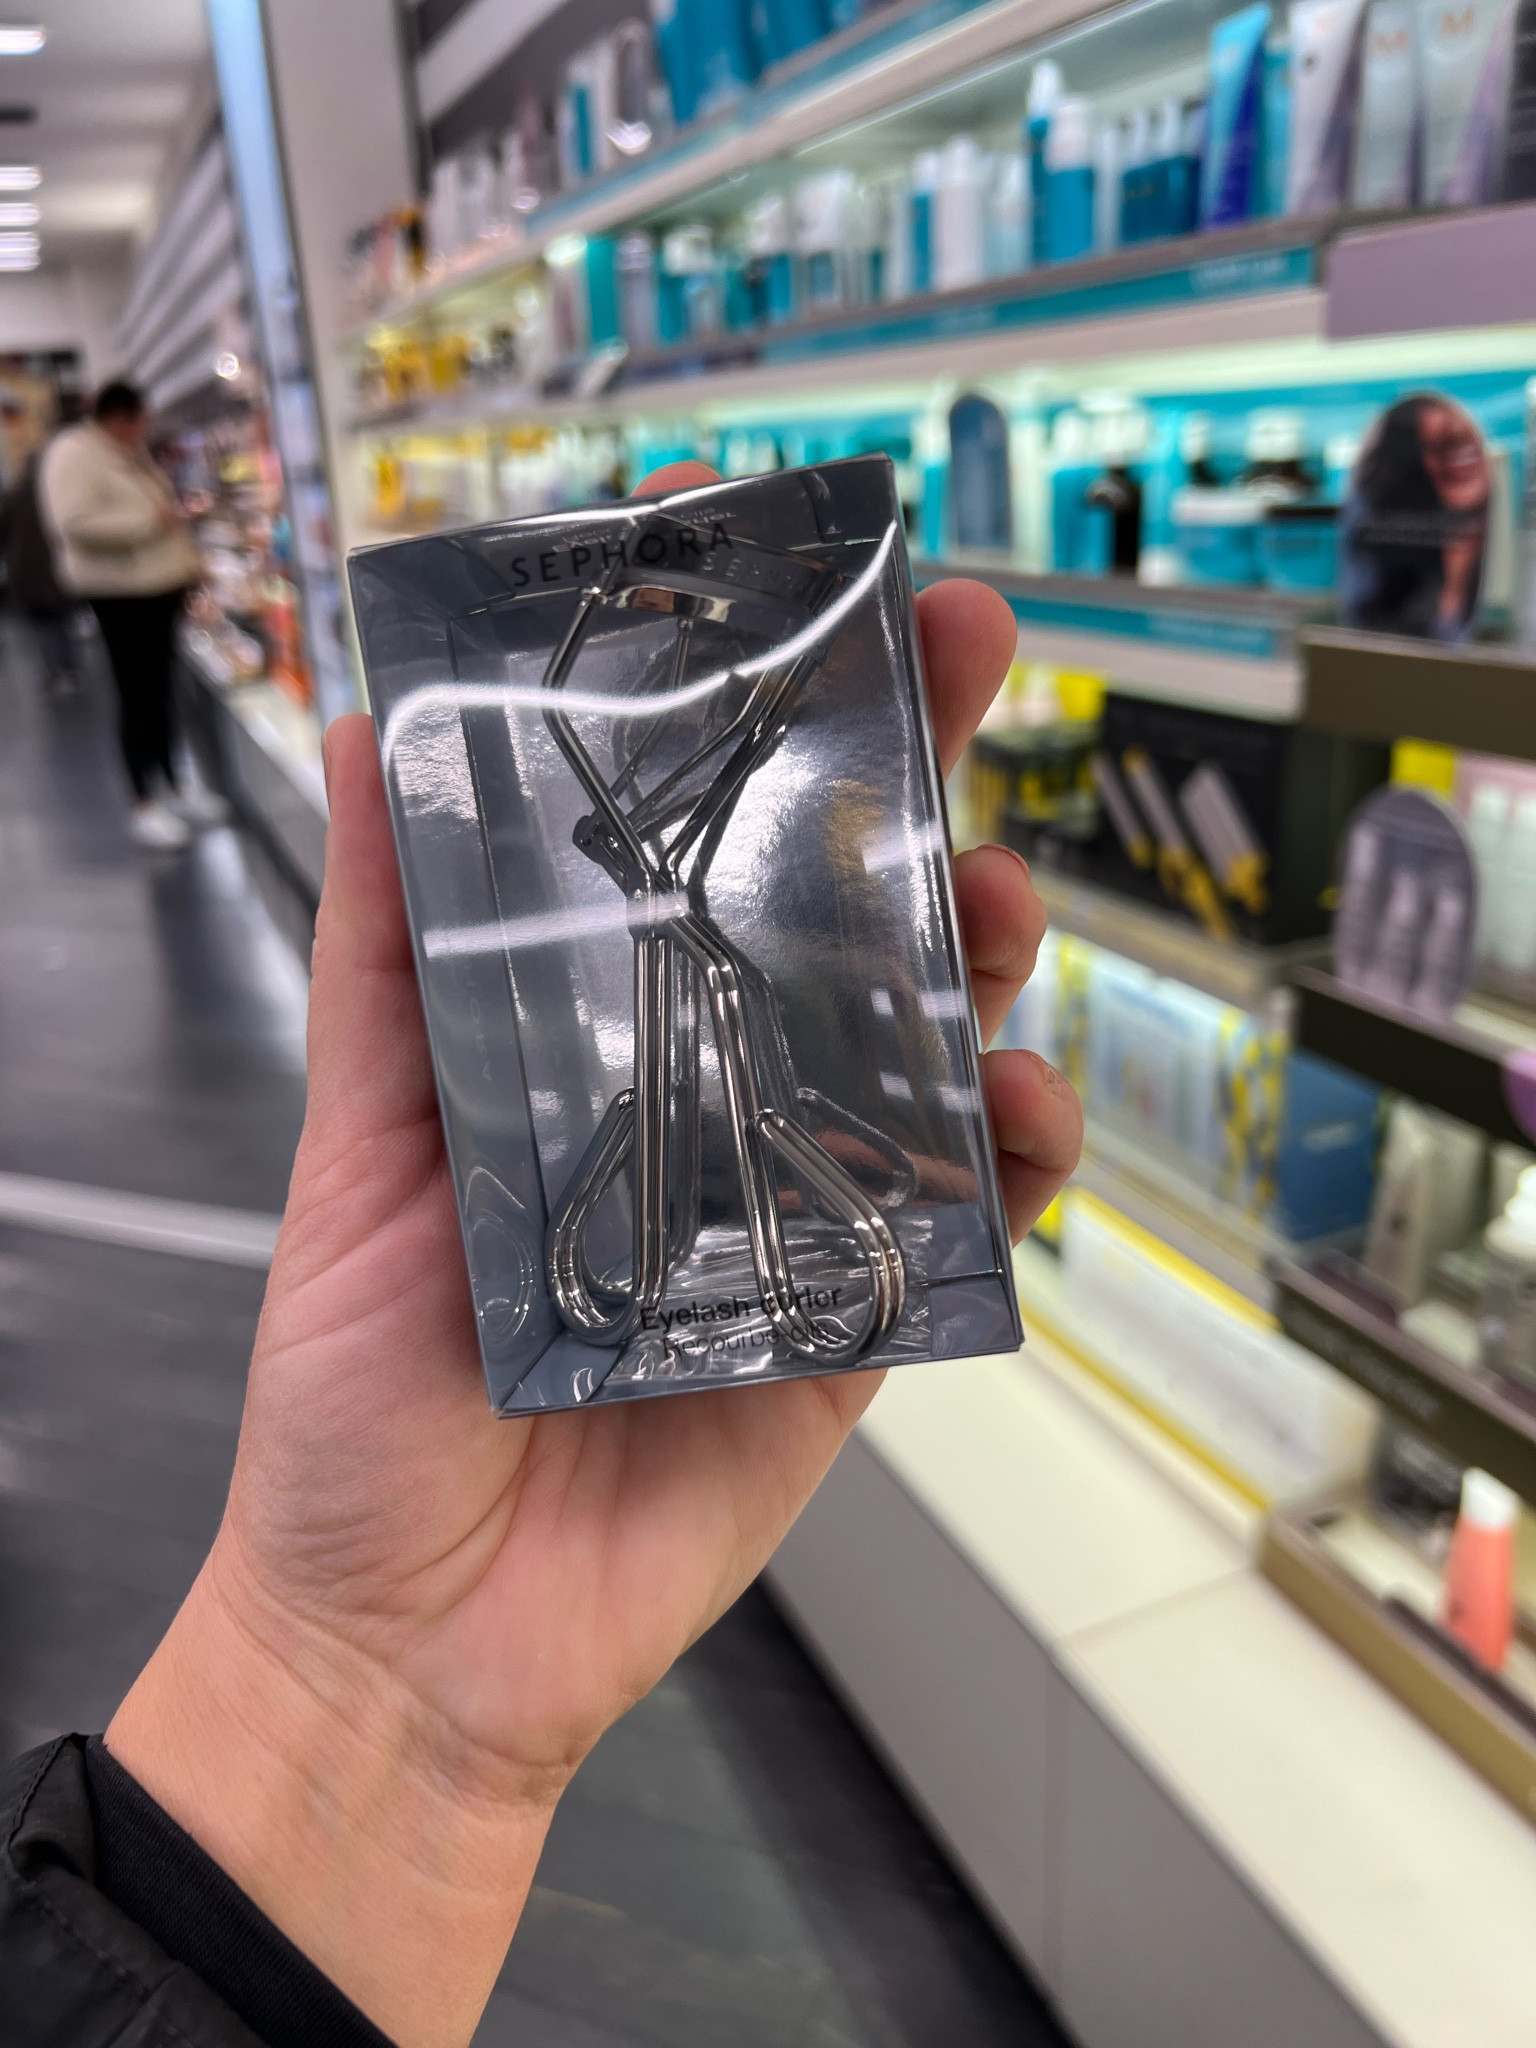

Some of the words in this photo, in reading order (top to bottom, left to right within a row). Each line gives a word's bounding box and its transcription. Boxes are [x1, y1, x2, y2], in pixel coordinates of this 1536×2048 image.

[511, 523, 733, 587] SEPHORA
[640, 1295, 751, 1334] Eyelash
[661, 1327, 780, 1359] Recourbe
